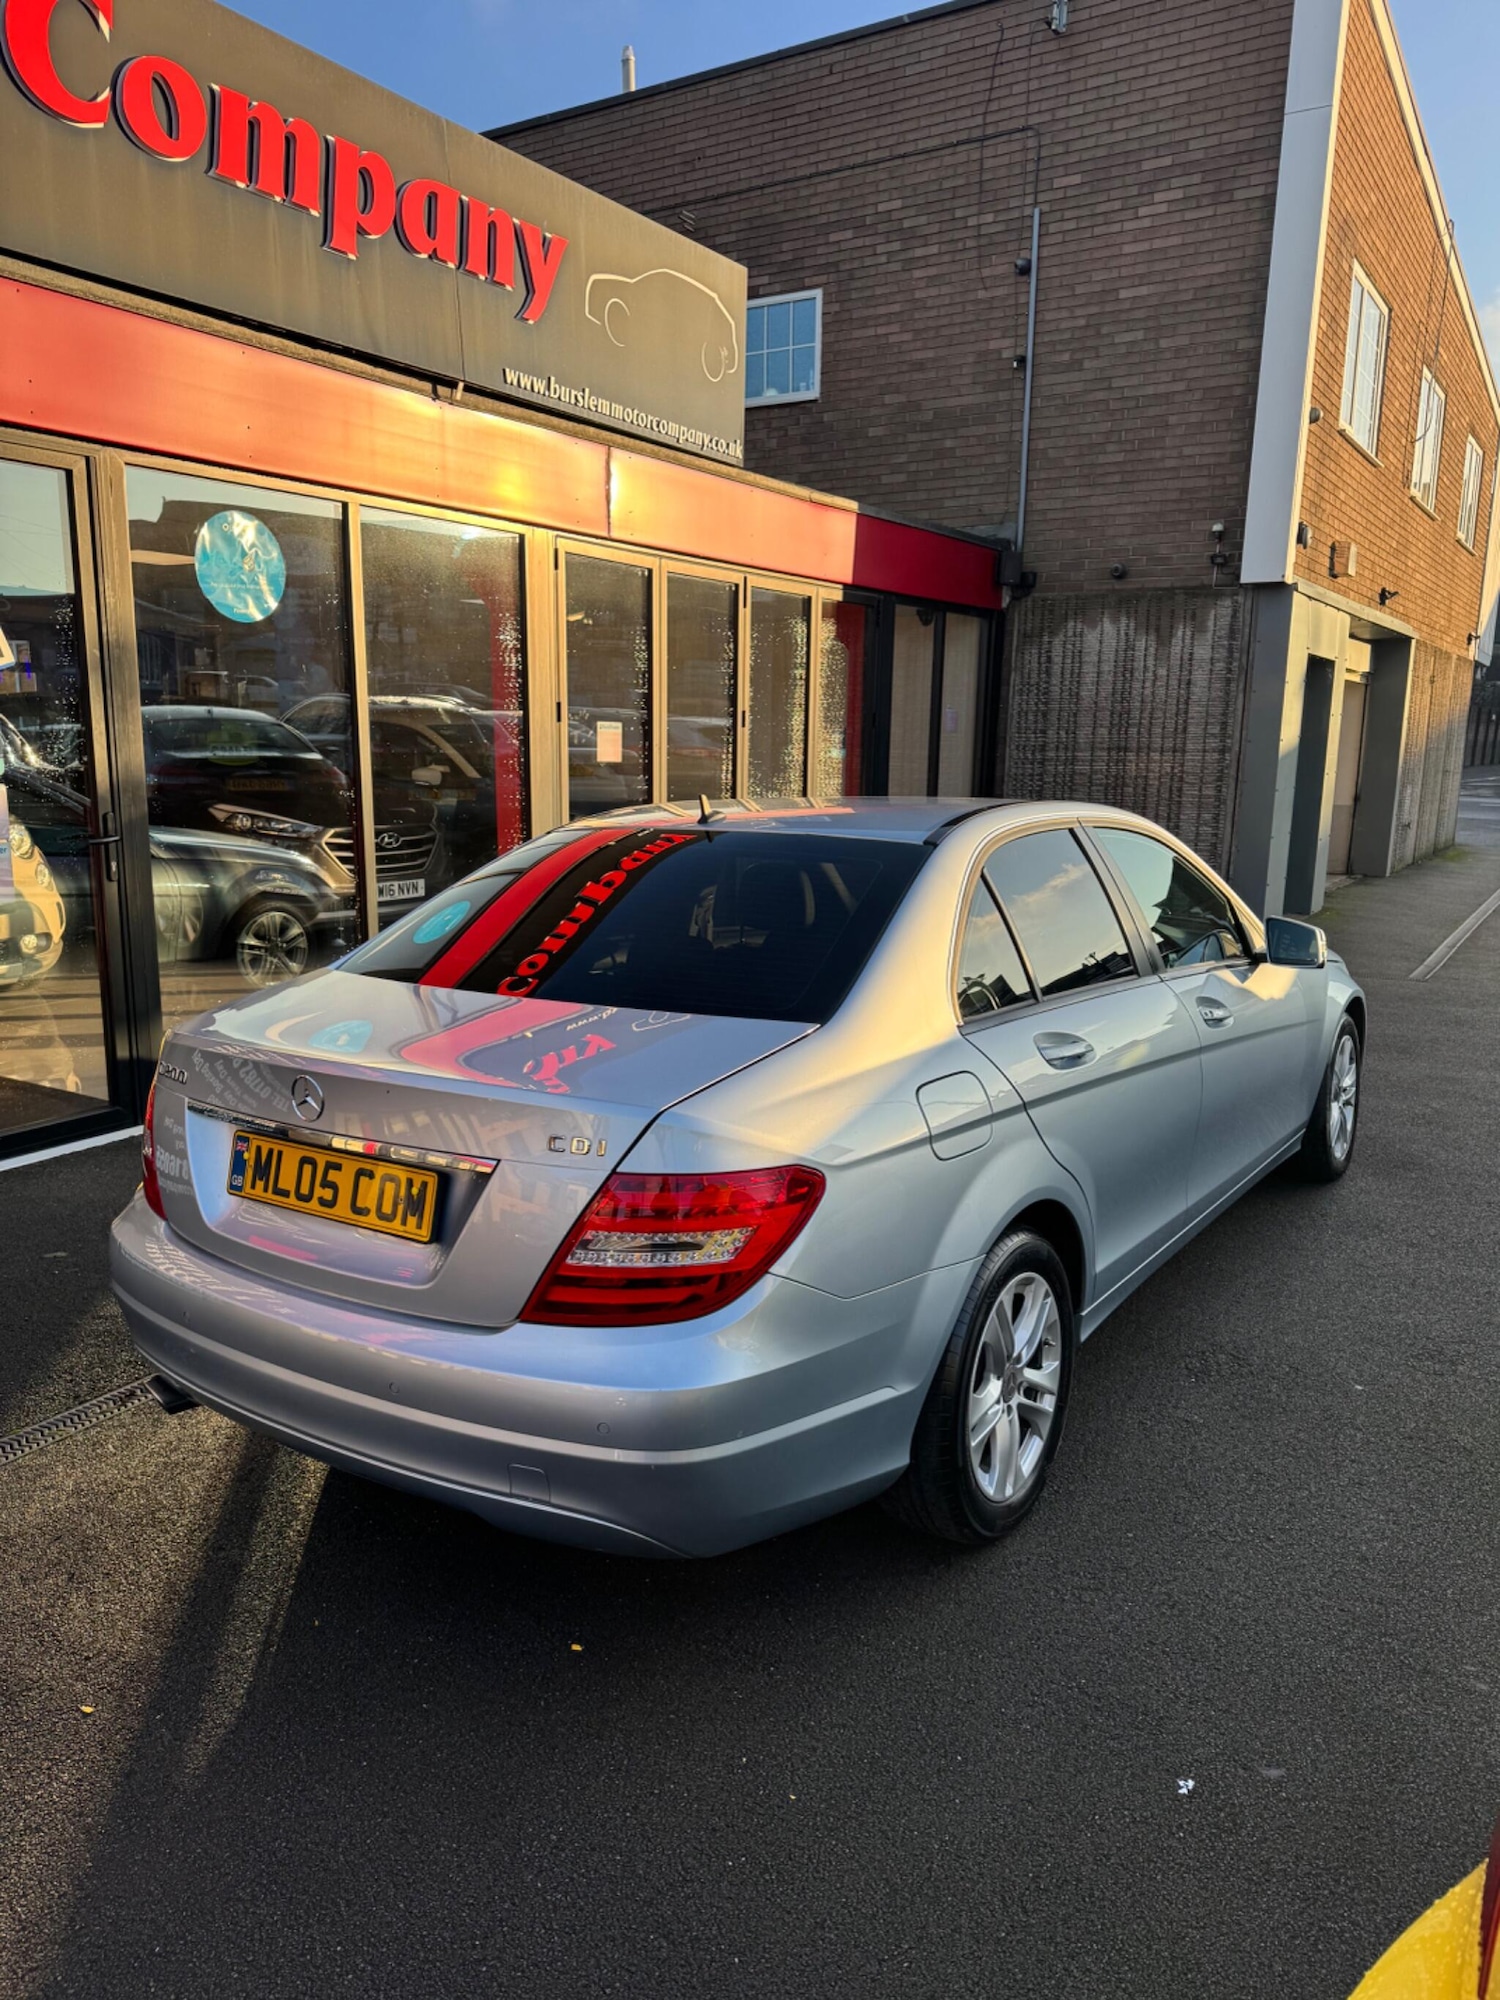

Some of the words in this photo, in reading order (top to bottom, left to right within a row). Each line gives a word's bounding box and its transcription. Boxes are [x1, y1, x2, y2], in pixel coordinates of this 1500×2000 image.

[2, 0, 570, 324] Company
[503, 367, 743, 459] www.burslemmotorcompany.co.uk
[398, 881, 419, 896] NVN
[548, 1135, 608, 1157] CDI
[230, 1174, 243, 1187] GB
[250, 1144, 343, 1209] ML05
[350, 1167, 428, 1230] COM
